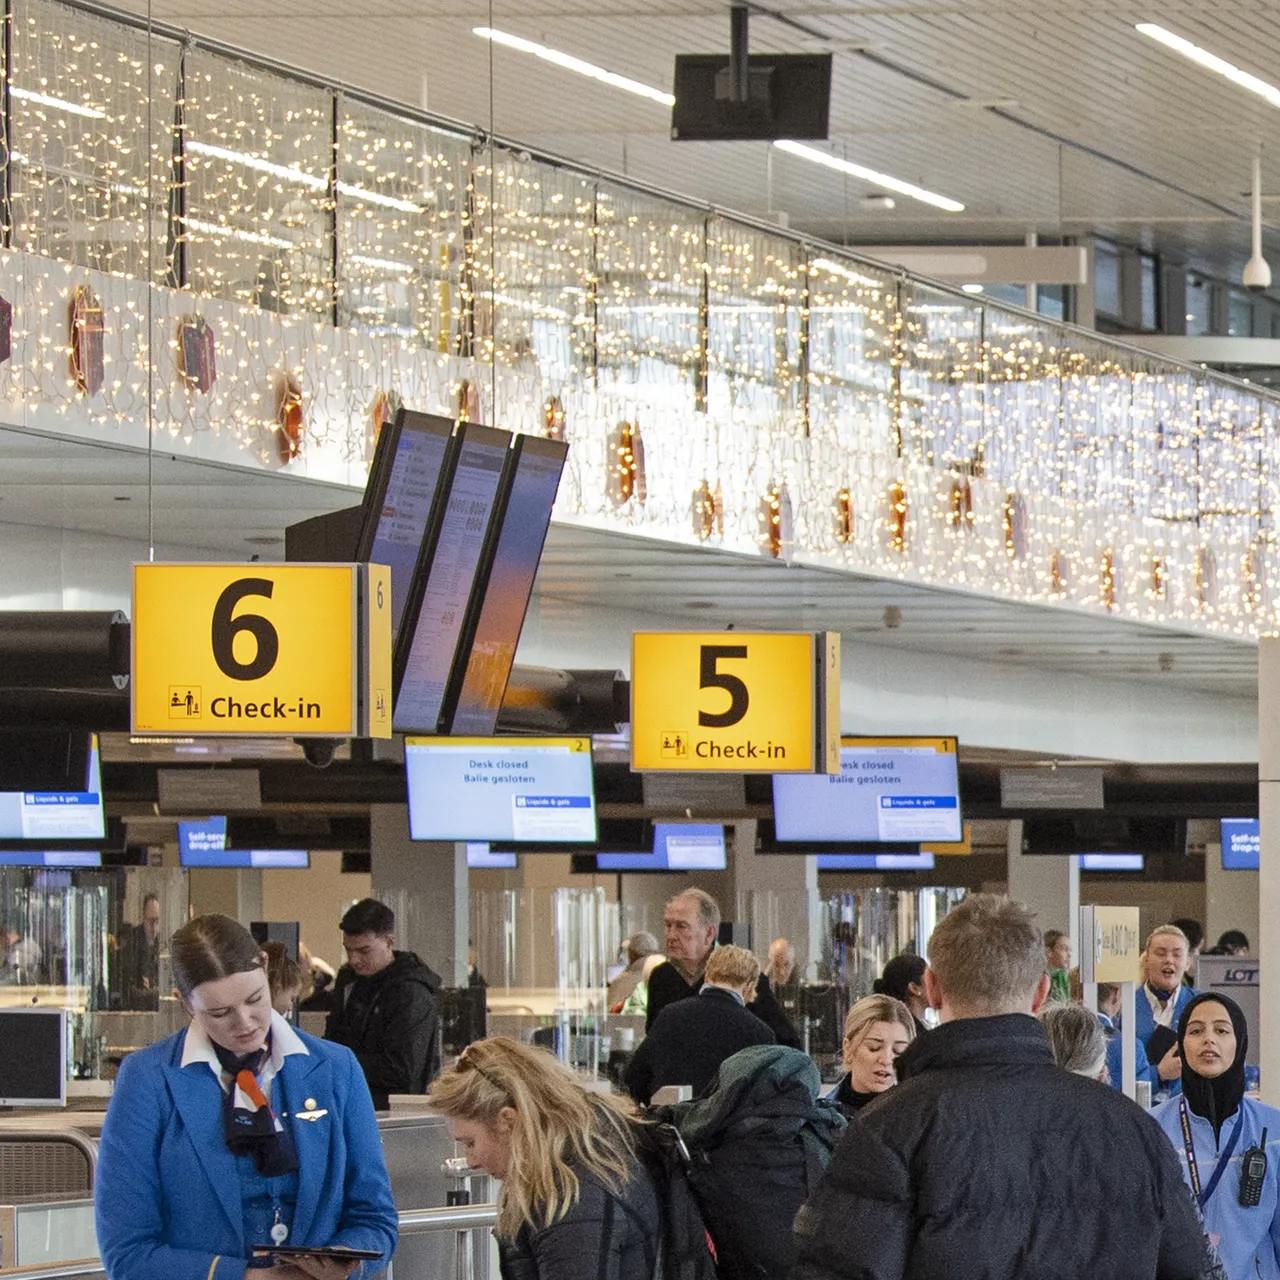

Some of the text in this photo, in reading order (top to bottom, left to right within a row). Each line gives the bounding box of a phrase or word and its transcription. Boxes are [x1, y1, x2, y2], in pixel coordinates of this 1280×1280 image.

[377, 581, 383, 609] 6
[210, 576, 280, 683] 6
[697, 643, 750, 730] 5
[211, 697, 321, 719] Check-in
[575, 741, 582, 752] 2
[695, 739, 786, 760] Check-in
[941, 740, 949, 752] 1
[469, 760, 528, 769] Desk closed
[862, 760, 895, 770] closed
[464, 774, 535, 785] Balie gesloten
[829, 774, 901, 787] Balie gesloten
[1224, 969, 1259, 982] LOT
